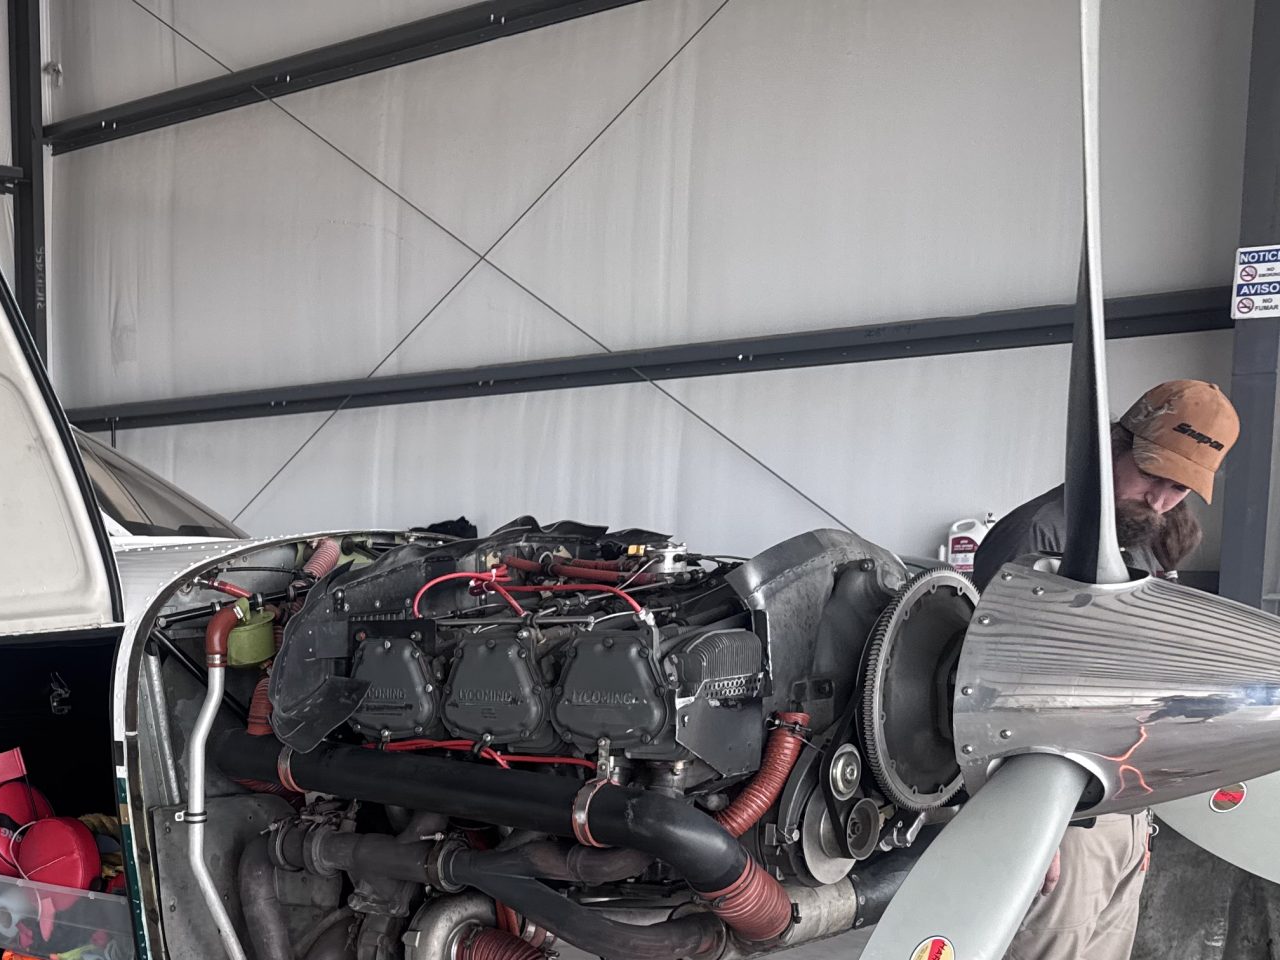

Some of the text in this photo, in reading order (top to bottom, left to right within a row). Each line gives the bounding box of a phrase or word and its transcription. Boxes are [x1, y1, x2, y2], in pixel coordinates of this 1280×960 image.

[1240, 283, 1279, 295] AVISO
[367, 687, 407, 699] COMING
[459, 688, 512, 702] LYCOMING
[572, 689, 633, 704] LYCOMING
